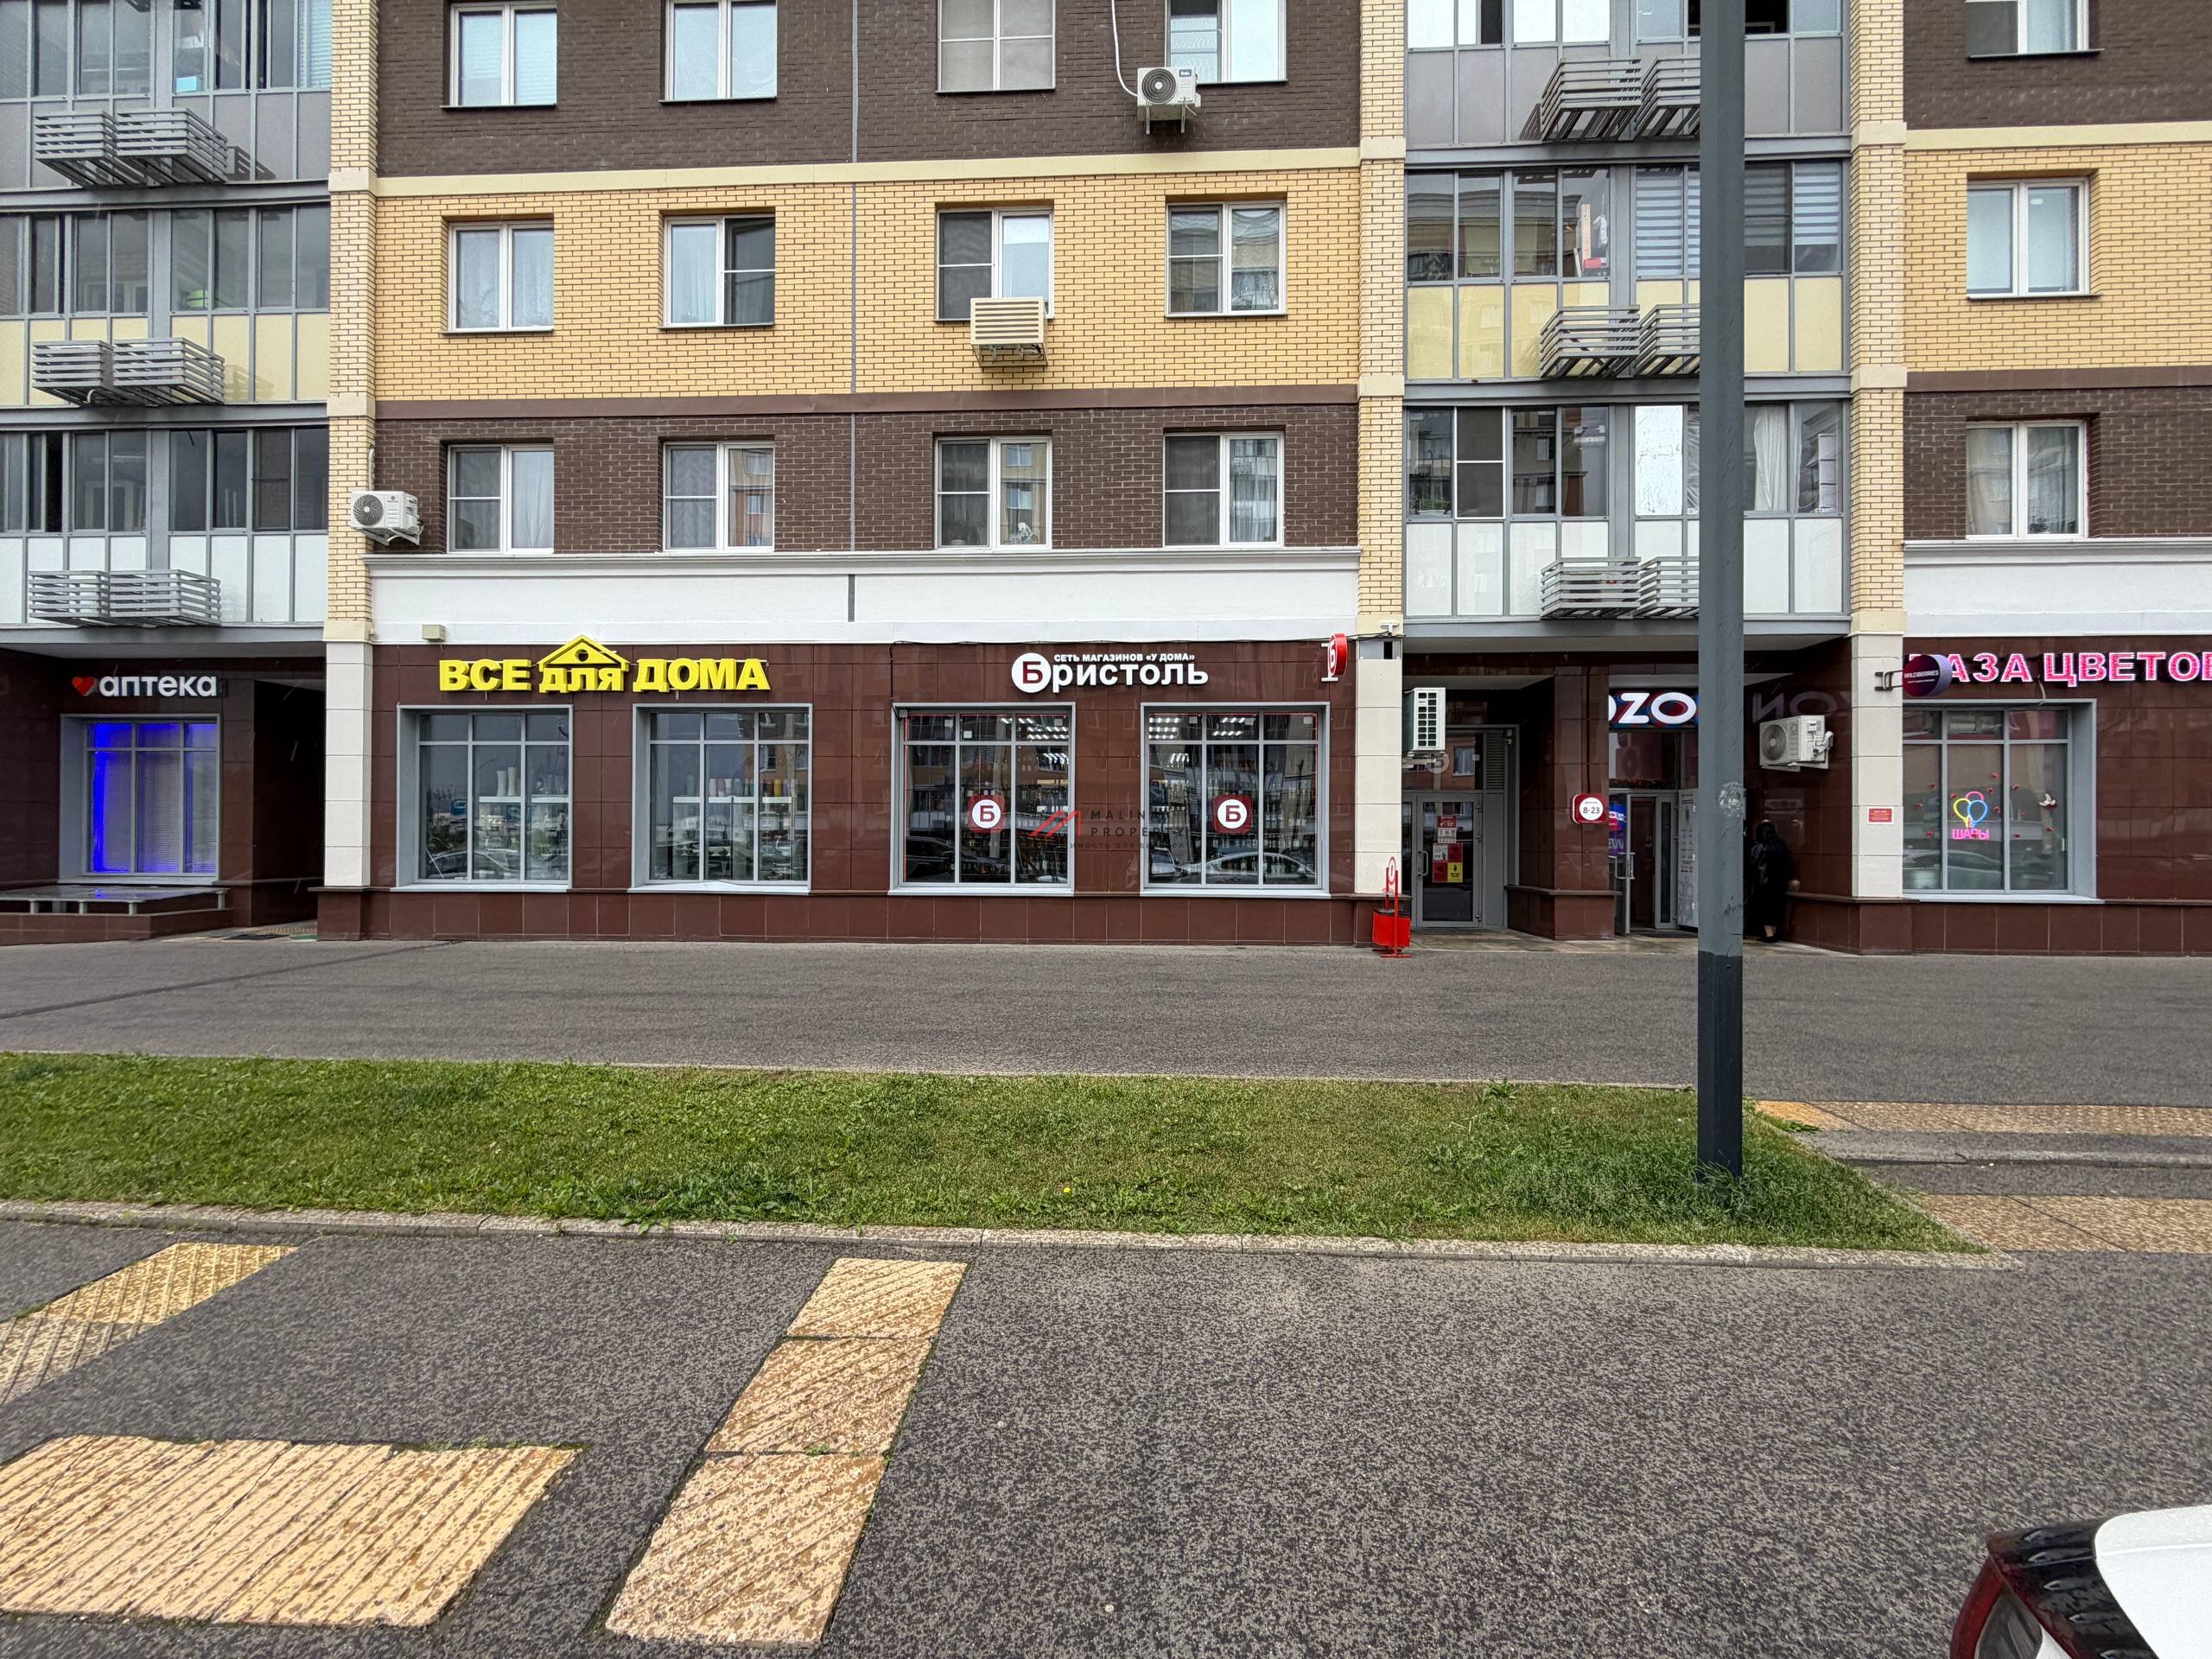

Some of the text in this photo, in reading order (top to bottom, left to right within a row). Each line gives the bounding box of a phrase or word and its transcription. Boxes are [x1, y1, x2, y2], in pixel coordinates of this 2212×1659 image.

[1053, 654, 1080, 663] СЕТЬ
[1082, 653, 1143, 662] МАГАЗИНОВ
[1159, 653, 1196, 663] ДОМА»
[1909, 652, 2032, 683] АЗА
[439, 658, 531, 691] ВСЕ
[633, 658, 771, 693] ДОМА
[1022, 659, 1209, 693] Бристоль
[99, 676, 218, 697] аптека
[1608, 692, 1697, 724] ZO
[980, 804, 995, 823] Б
[1225, 804, 1242, 823] Б
[1952, 828, 1991, 841] ШАРЫ
